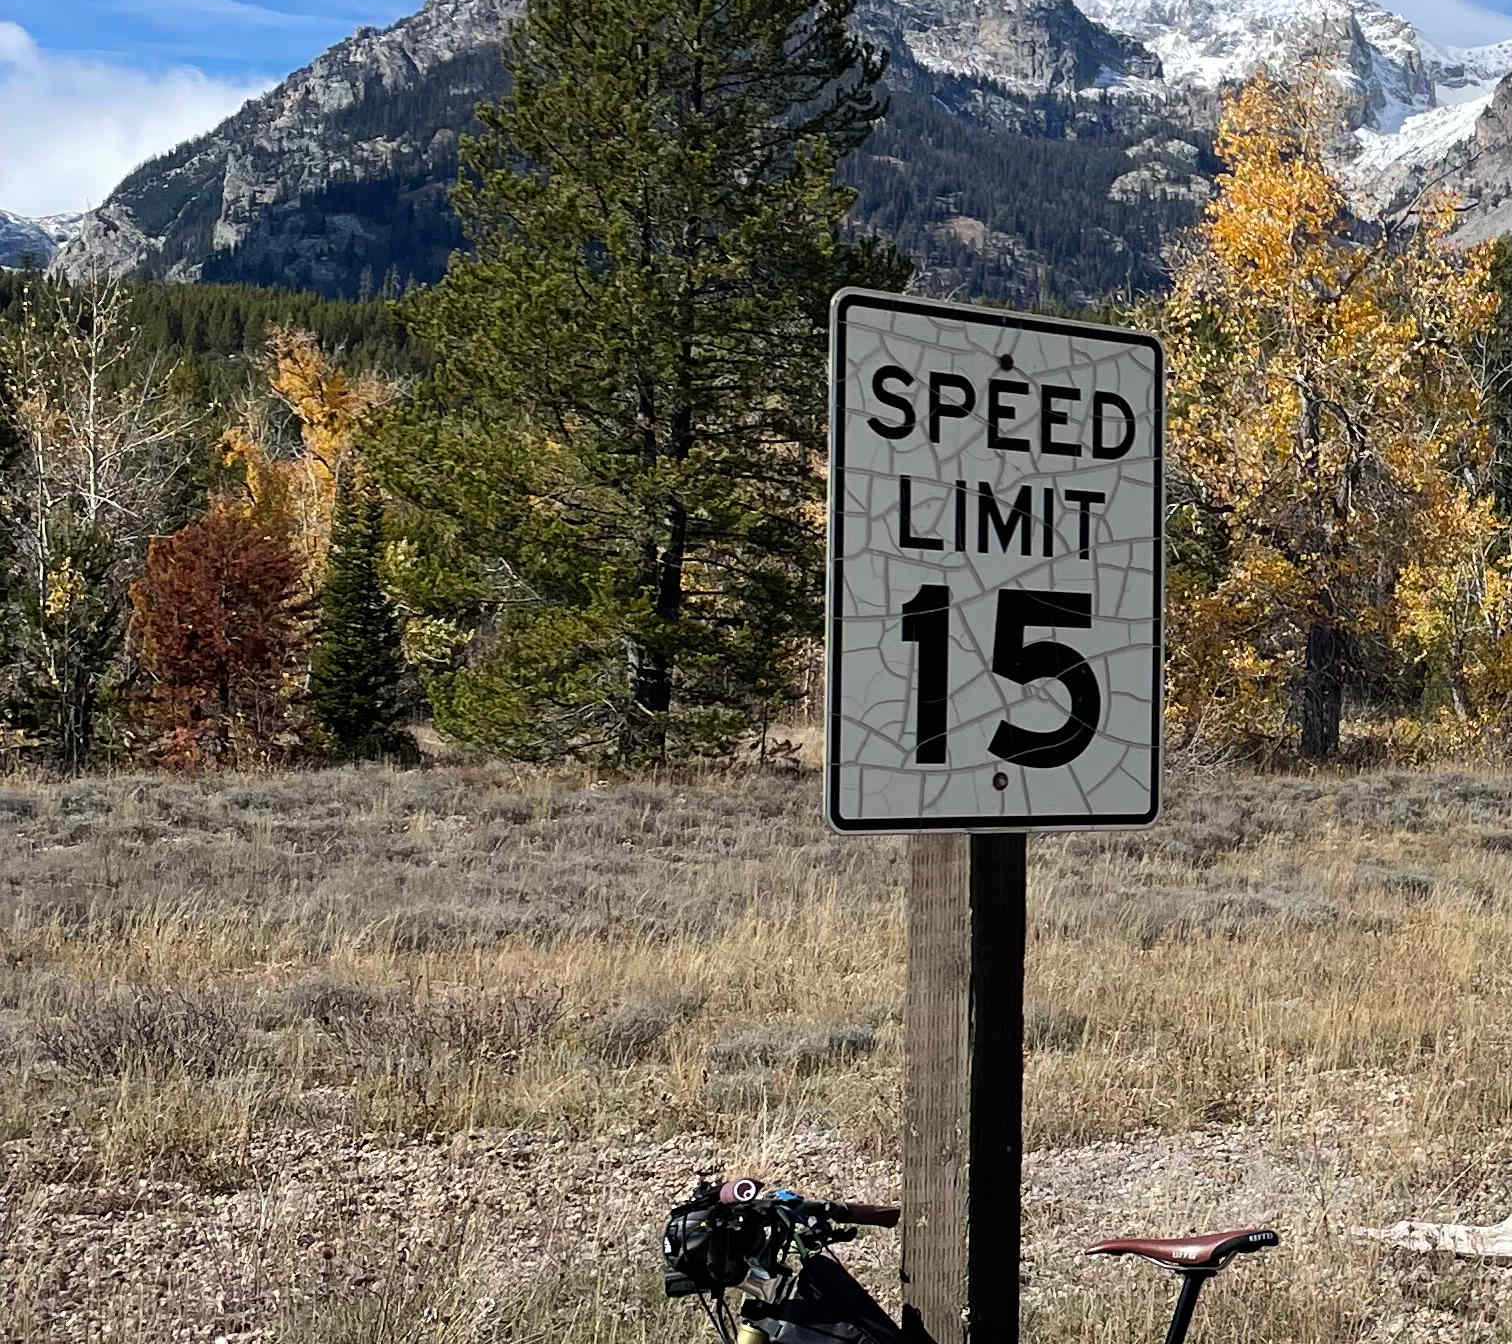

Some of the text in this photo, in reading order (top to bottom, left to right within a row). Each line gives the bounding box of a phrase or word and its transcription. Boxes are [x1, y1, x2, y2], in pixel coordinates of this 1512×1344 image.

[867, 365, 1136, 460] SPEED
[899, 475, 1105, 560] LIMIT
[902, 584, 1101, 769] 15
